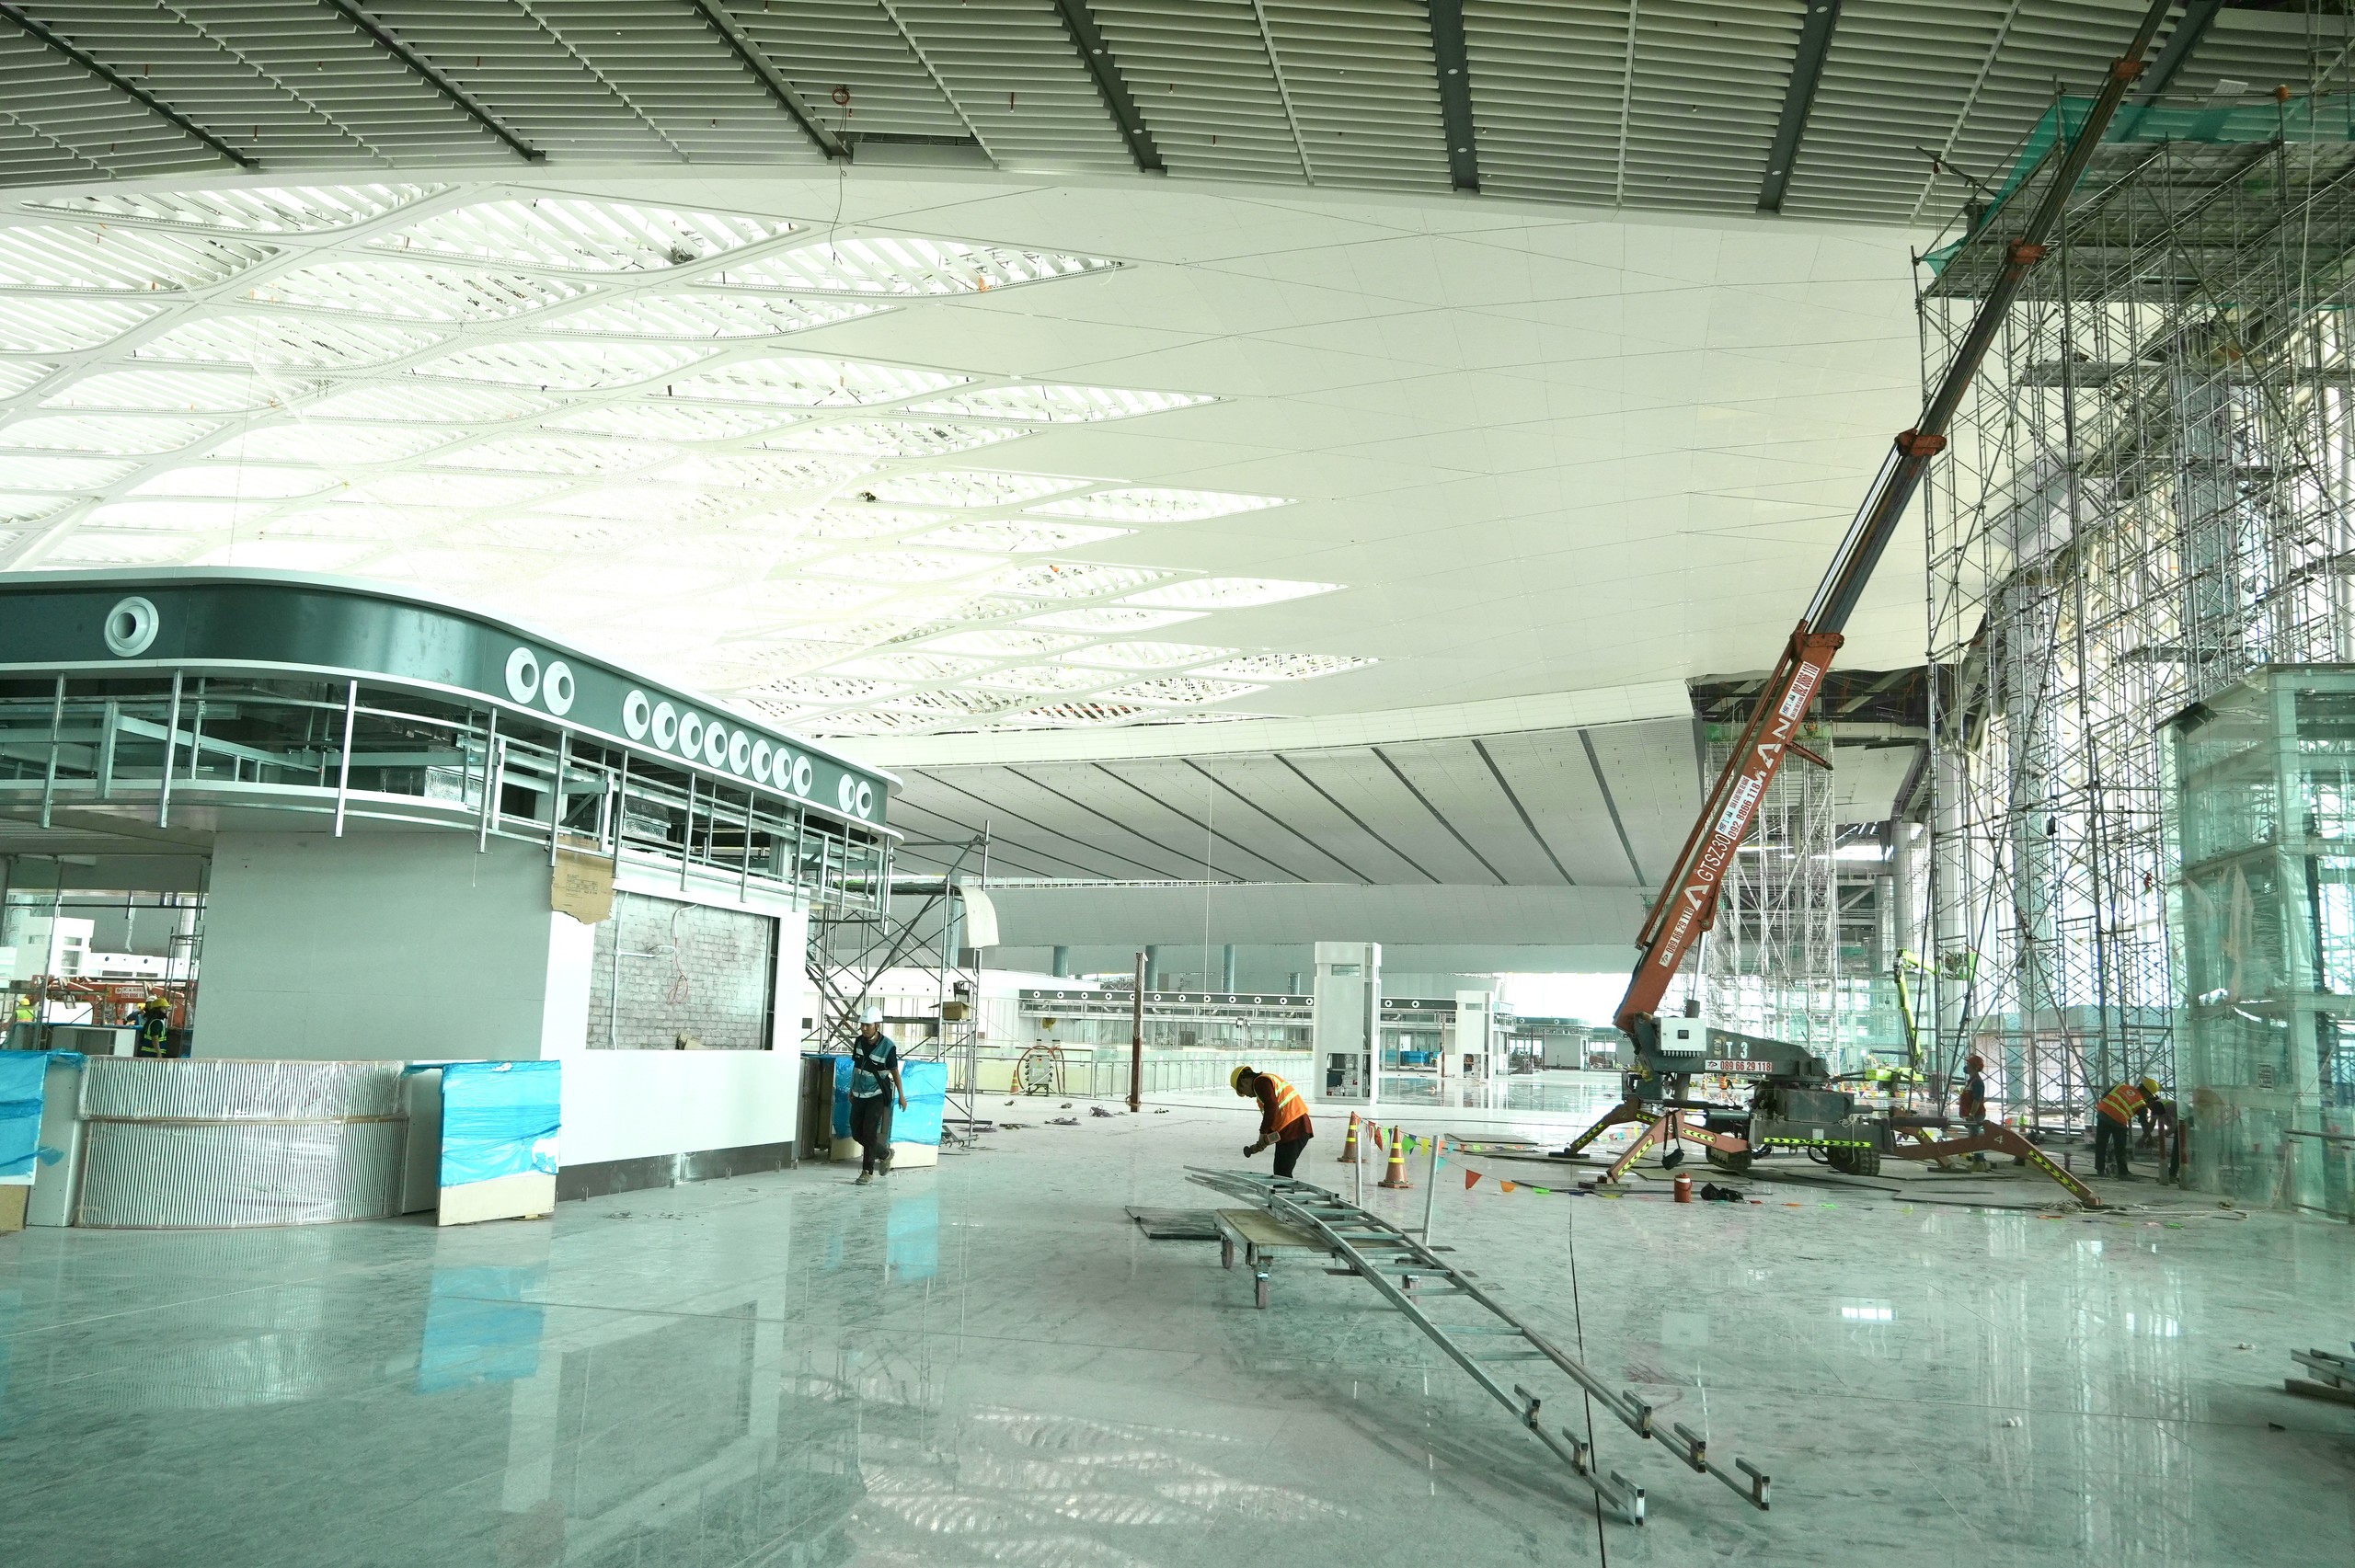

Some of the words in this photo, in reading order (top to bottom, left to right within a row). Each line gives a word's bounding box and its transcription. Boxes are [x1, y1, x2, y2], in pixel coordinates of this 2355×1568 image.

[1802, 662, 1819, 676] 118
[1728, 820, 1741, 838] 092
[1736, 799, 1752, 820] 8866
[1747, 783, 1761, 798] 118
[1697, 833, 1731, 882] GTSZ30
[1683, 907, 1694, 921] 118
[1677, 921, 1687, 933] 29
[1671, 930, 1683, 942] 66
[1665, 939, 1678, 954] 089
[1726, 1041, 1733, 1059] T
[1740, 1041, 1748, 1059] 3
[1719, 1060, 1734, 1070] 089
[1735, 1061, 1744, 1070] 66
[1746, 1061, 1756, 1071] 29
[1758, 1062, 1771, 1071] 118
[1993, 1135, 2004, 1145] 4
